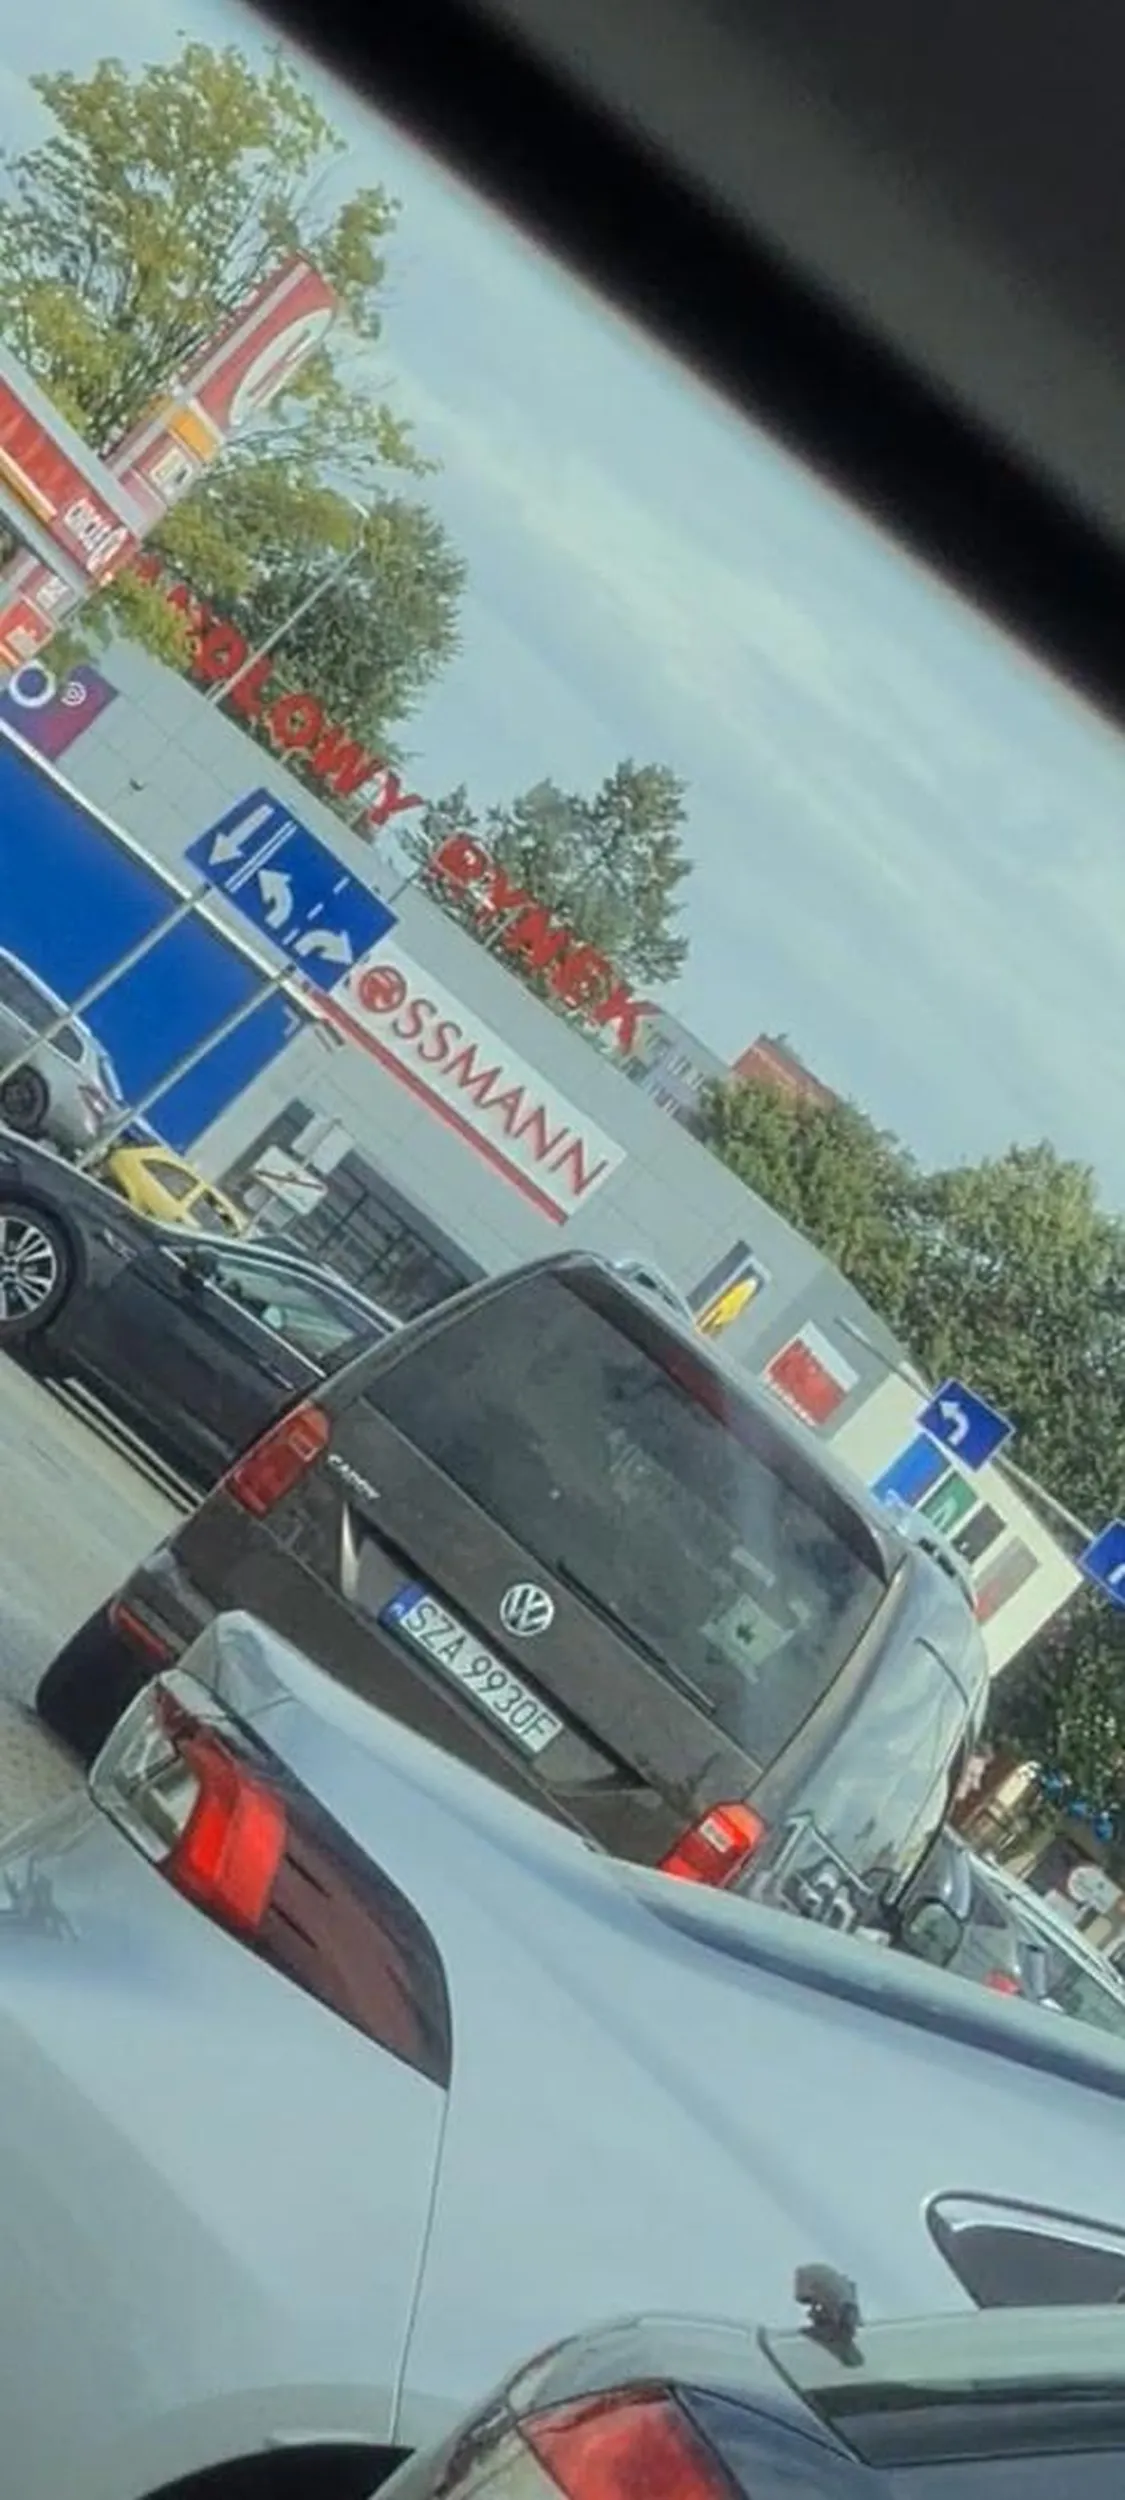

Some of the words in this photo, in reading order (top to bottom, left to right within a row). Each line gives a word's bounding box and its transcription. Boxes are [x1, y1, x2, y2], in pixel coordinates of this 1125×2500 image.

[357, 964, 609, 1197] OSSMANN
[405, 1602, 467, 1663] SZA
[461, 1654, 559, 1737] 9930F
